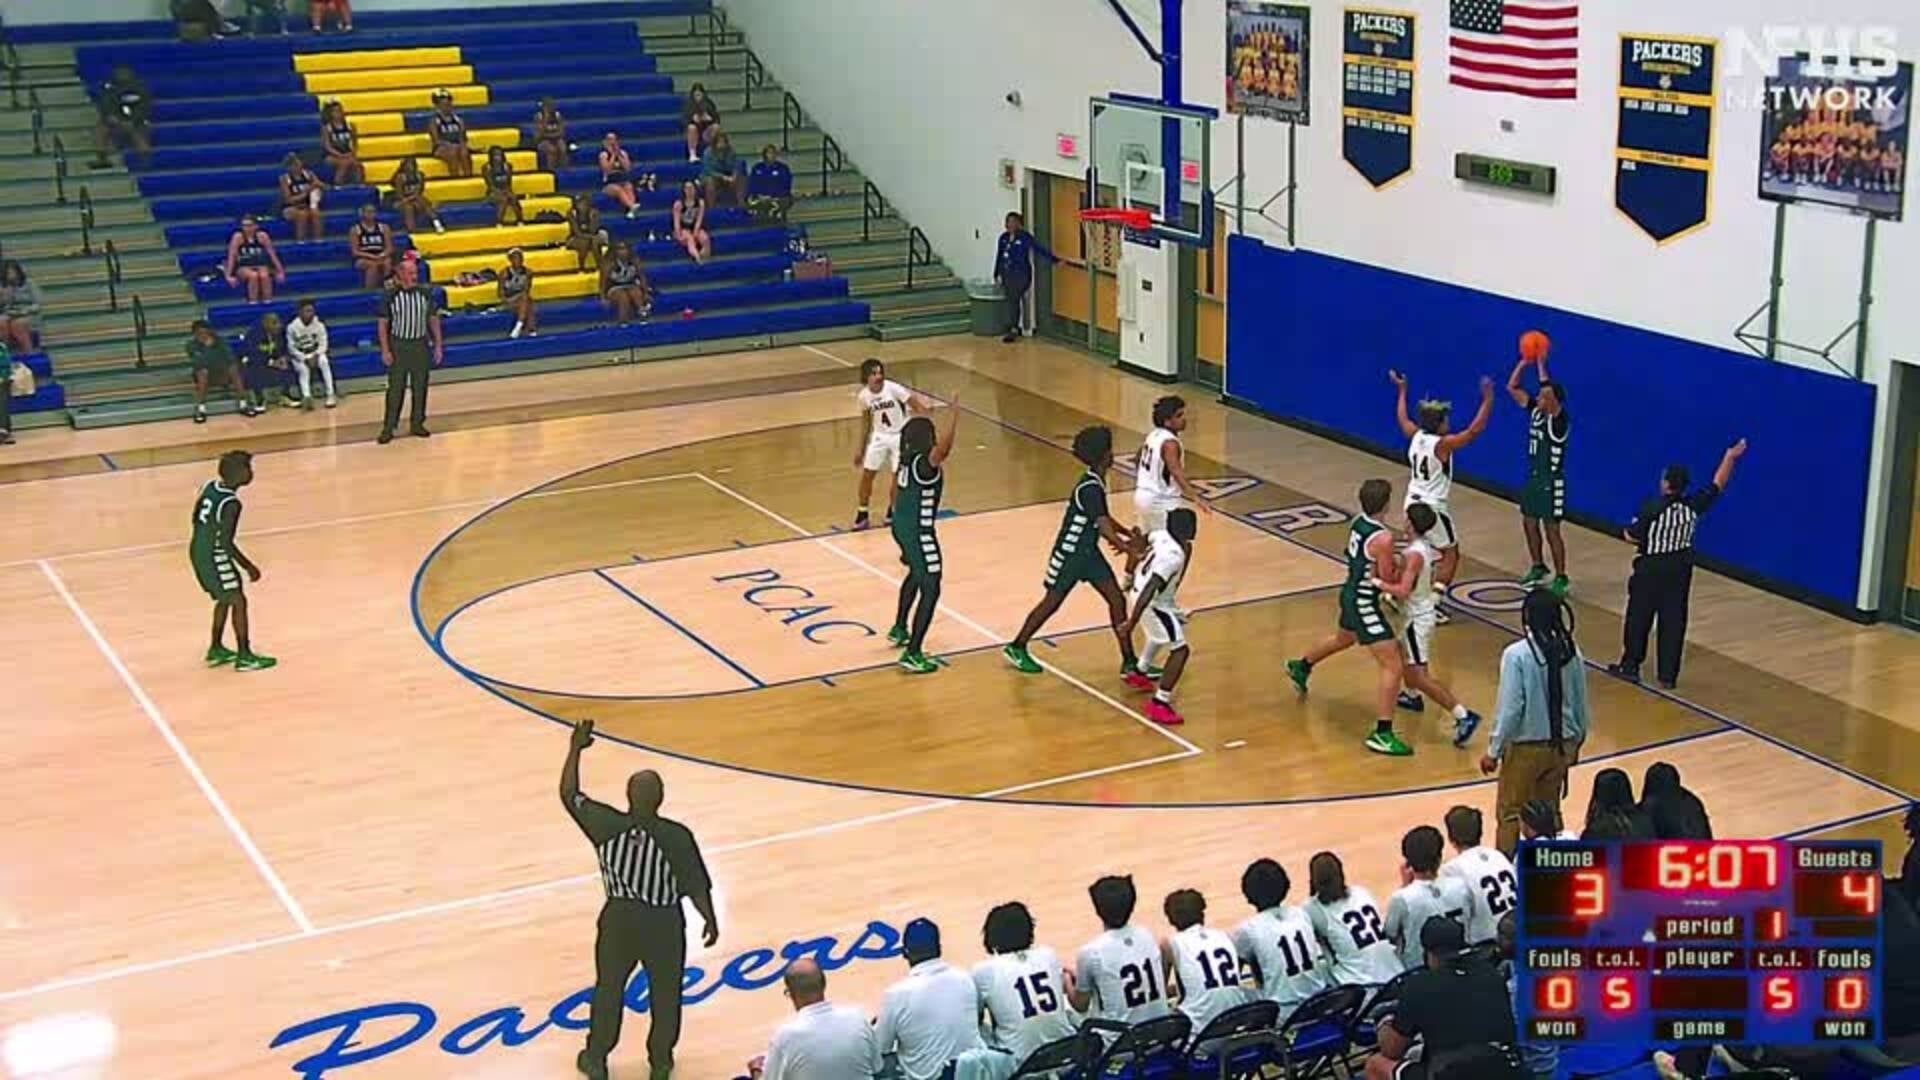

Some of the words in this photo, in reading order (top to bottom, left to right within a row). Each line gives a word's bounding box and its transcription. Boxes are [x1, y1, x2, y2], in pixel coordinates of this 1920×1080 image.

[1353, 13, 1406, 37] PACKERS
[1632, 41, 1703, 67] PACKERS
[881, 411, 892, 428] 4
[1411, 453, 1430, 481] 14
[199, 499, 212, 524] 2
[712, 568, 877, 645] PCAC
[1480, 870, 1516, 915] 23
[1343, 904, 1385, 949] 22
[1196, 948, 1239, 990] 12
[1277, 930, 1313, 977] 11
[1013, 971, 1058, 1018] 15
[1120, 957, 1160, 1008] 21
